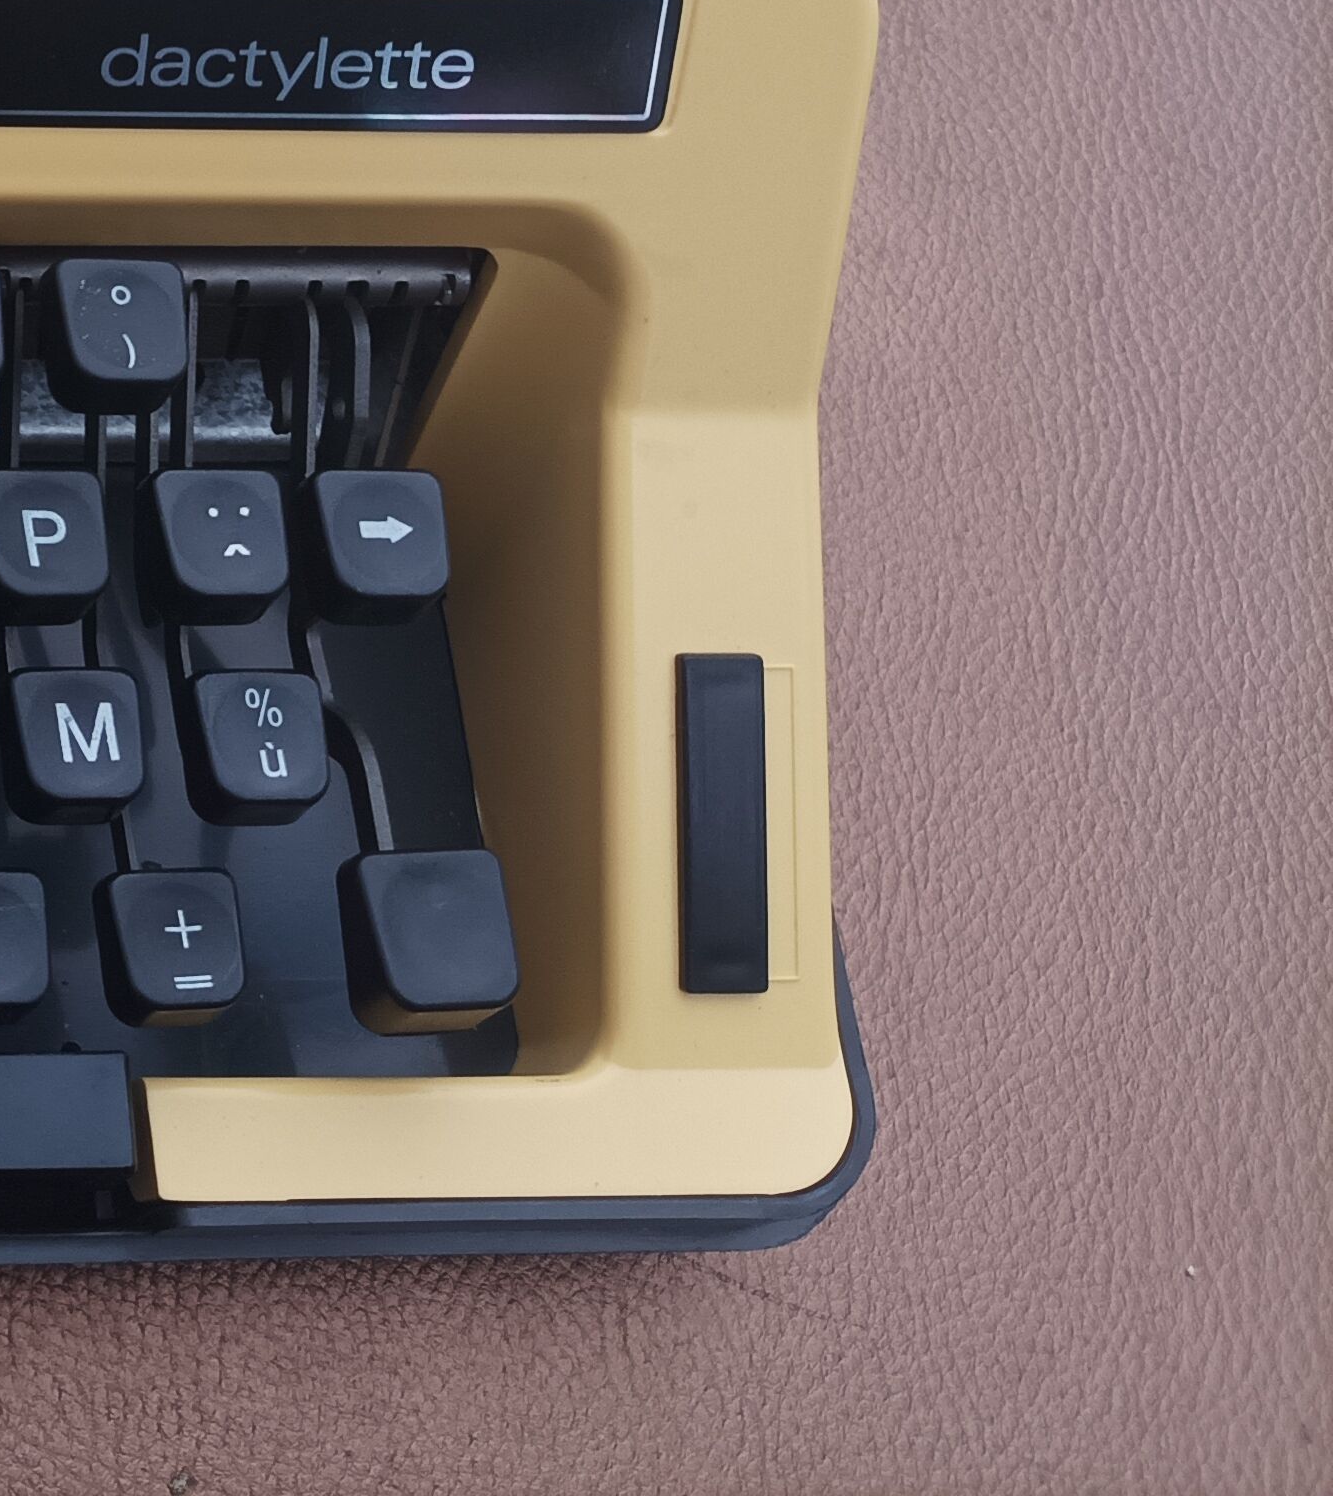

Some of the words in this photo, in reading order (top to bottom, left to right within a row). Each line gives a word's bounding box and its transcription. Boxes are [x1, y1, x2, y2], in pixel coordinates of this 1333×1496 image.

[100, 33, 475, 102] dactylette
[121, 333, 136, 369] )
[21, 509, 67, 568] P
[244, 688, 283, 727] %
[55, 702, 121, 763] M
[259, 741, 288, 778] ù
[164, 909, 202, 949] +
[173, 974, 214, 990] =
